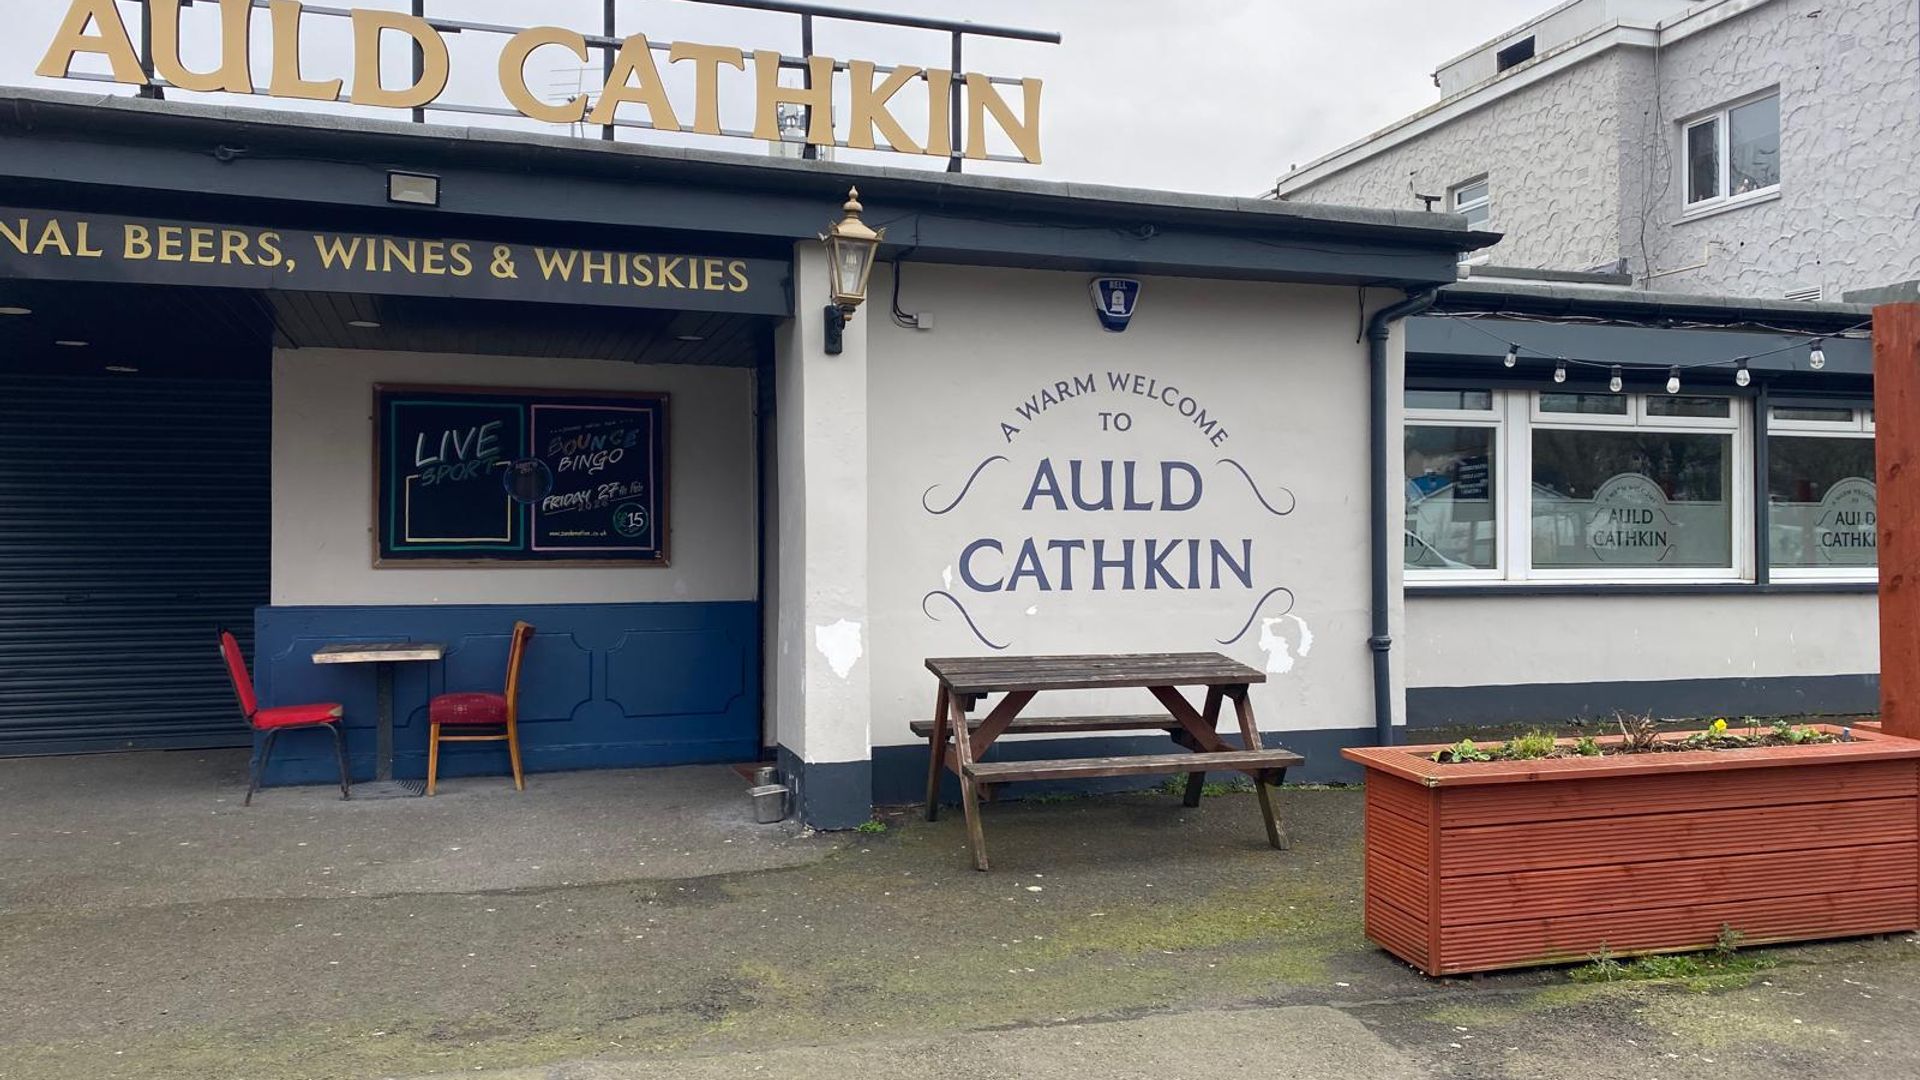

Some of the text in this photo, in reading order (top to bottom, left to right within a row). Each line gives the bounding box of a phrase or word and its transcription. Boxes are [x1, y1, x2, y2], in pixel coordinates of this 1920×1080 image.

[35, 0, 1043, 165] AULD CATHKIN
[123, 223, 297, 273] BEERS,
[313, 234, 473, 278] WINES
[490, 245, 518, 279] &
[533, 246, 749, 293] WHISKIES
[1000, 371, 1229, 448] A WARM WELCOME
[1098, 412, 1132, 431] TO
[415, 420, 502, 466] LIVE
[420, 456, 502, 487] SPORT
[558, 447, 624, 476] BINGO
[1022, 456, 1202, 511] AULD
[542, 489, 591, 512] FRIDAY
[1608, 508, 1654, 525] AULD
[1835, 512, 1876, 526] AULD
[1593, 531, 1667, 547] CATHKIN
[959, 537, 1253, 593] CATHKIN
